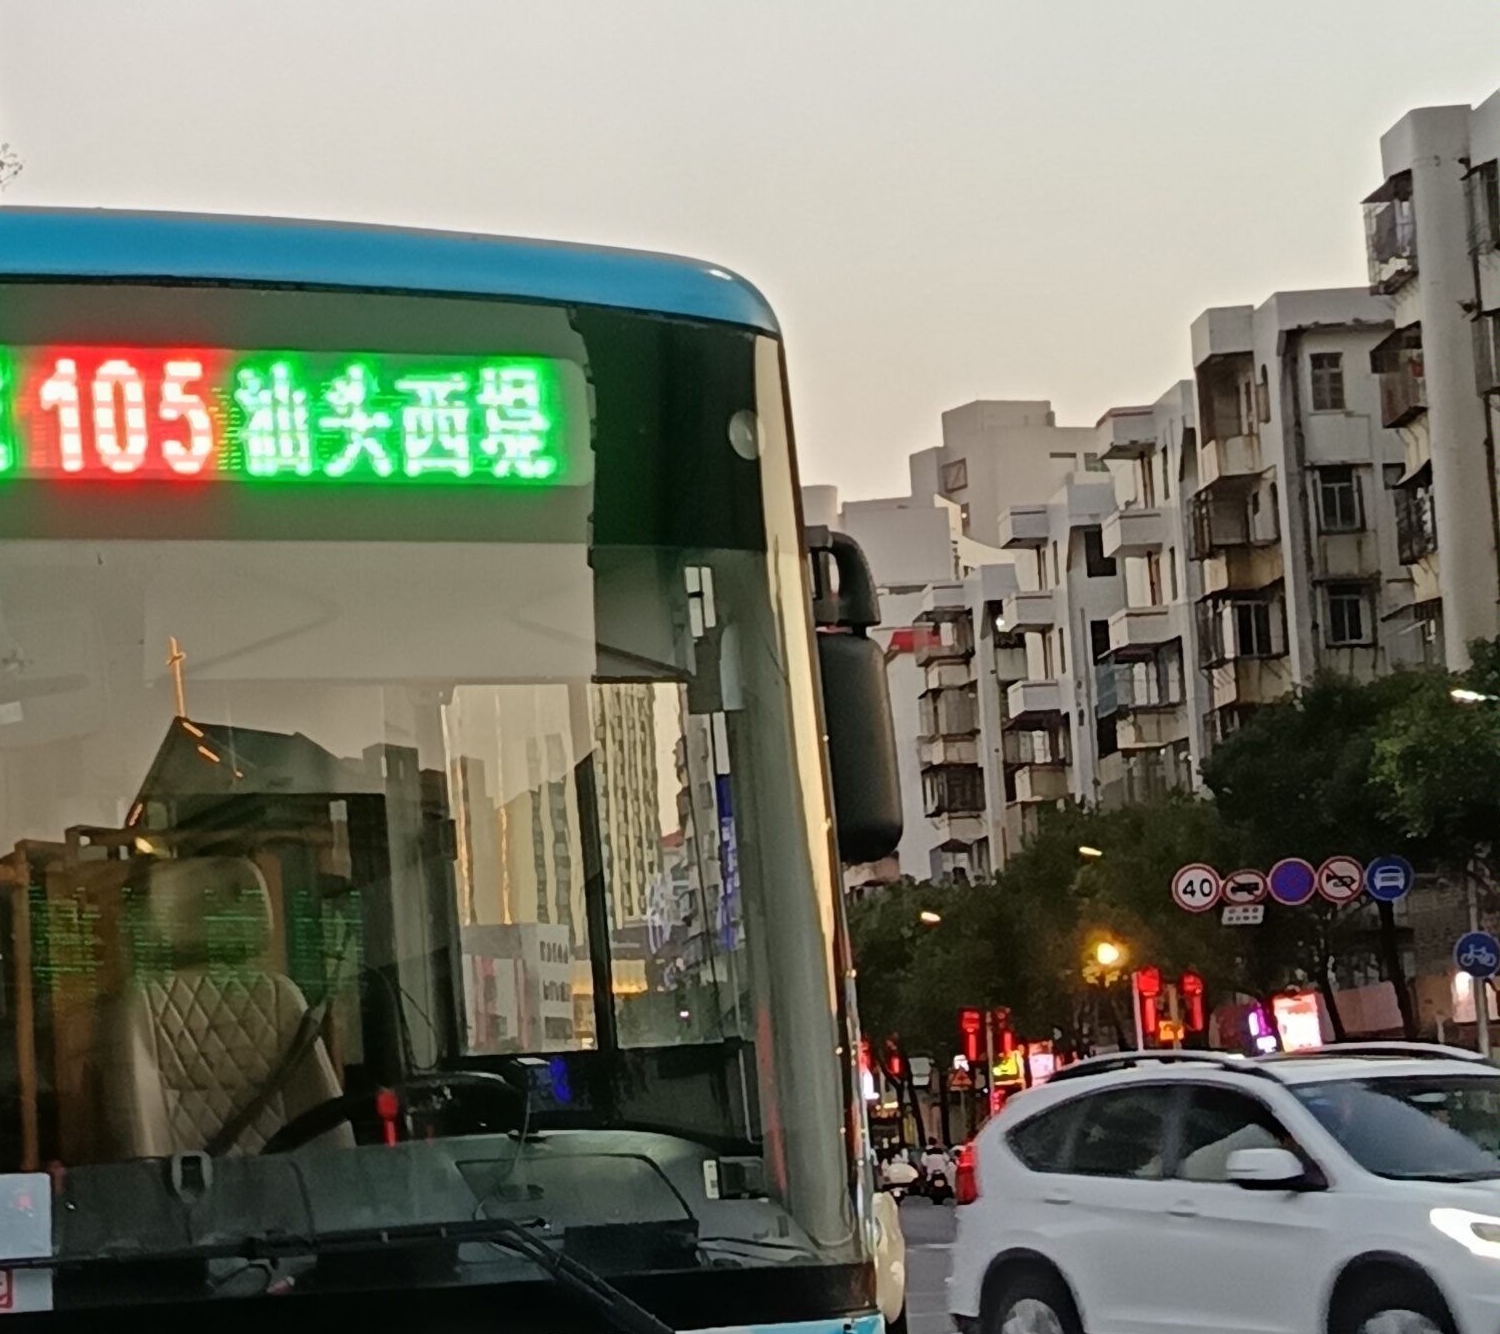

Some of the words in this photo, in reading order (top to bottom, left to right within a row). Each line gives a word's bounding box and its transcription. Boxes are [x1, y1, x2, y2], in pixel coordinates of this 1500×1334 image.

[40, 358, 215, 473] 105
[238, 363, 556, 478] 汕头西堤
[1182, 877, 1213, 899] 40
